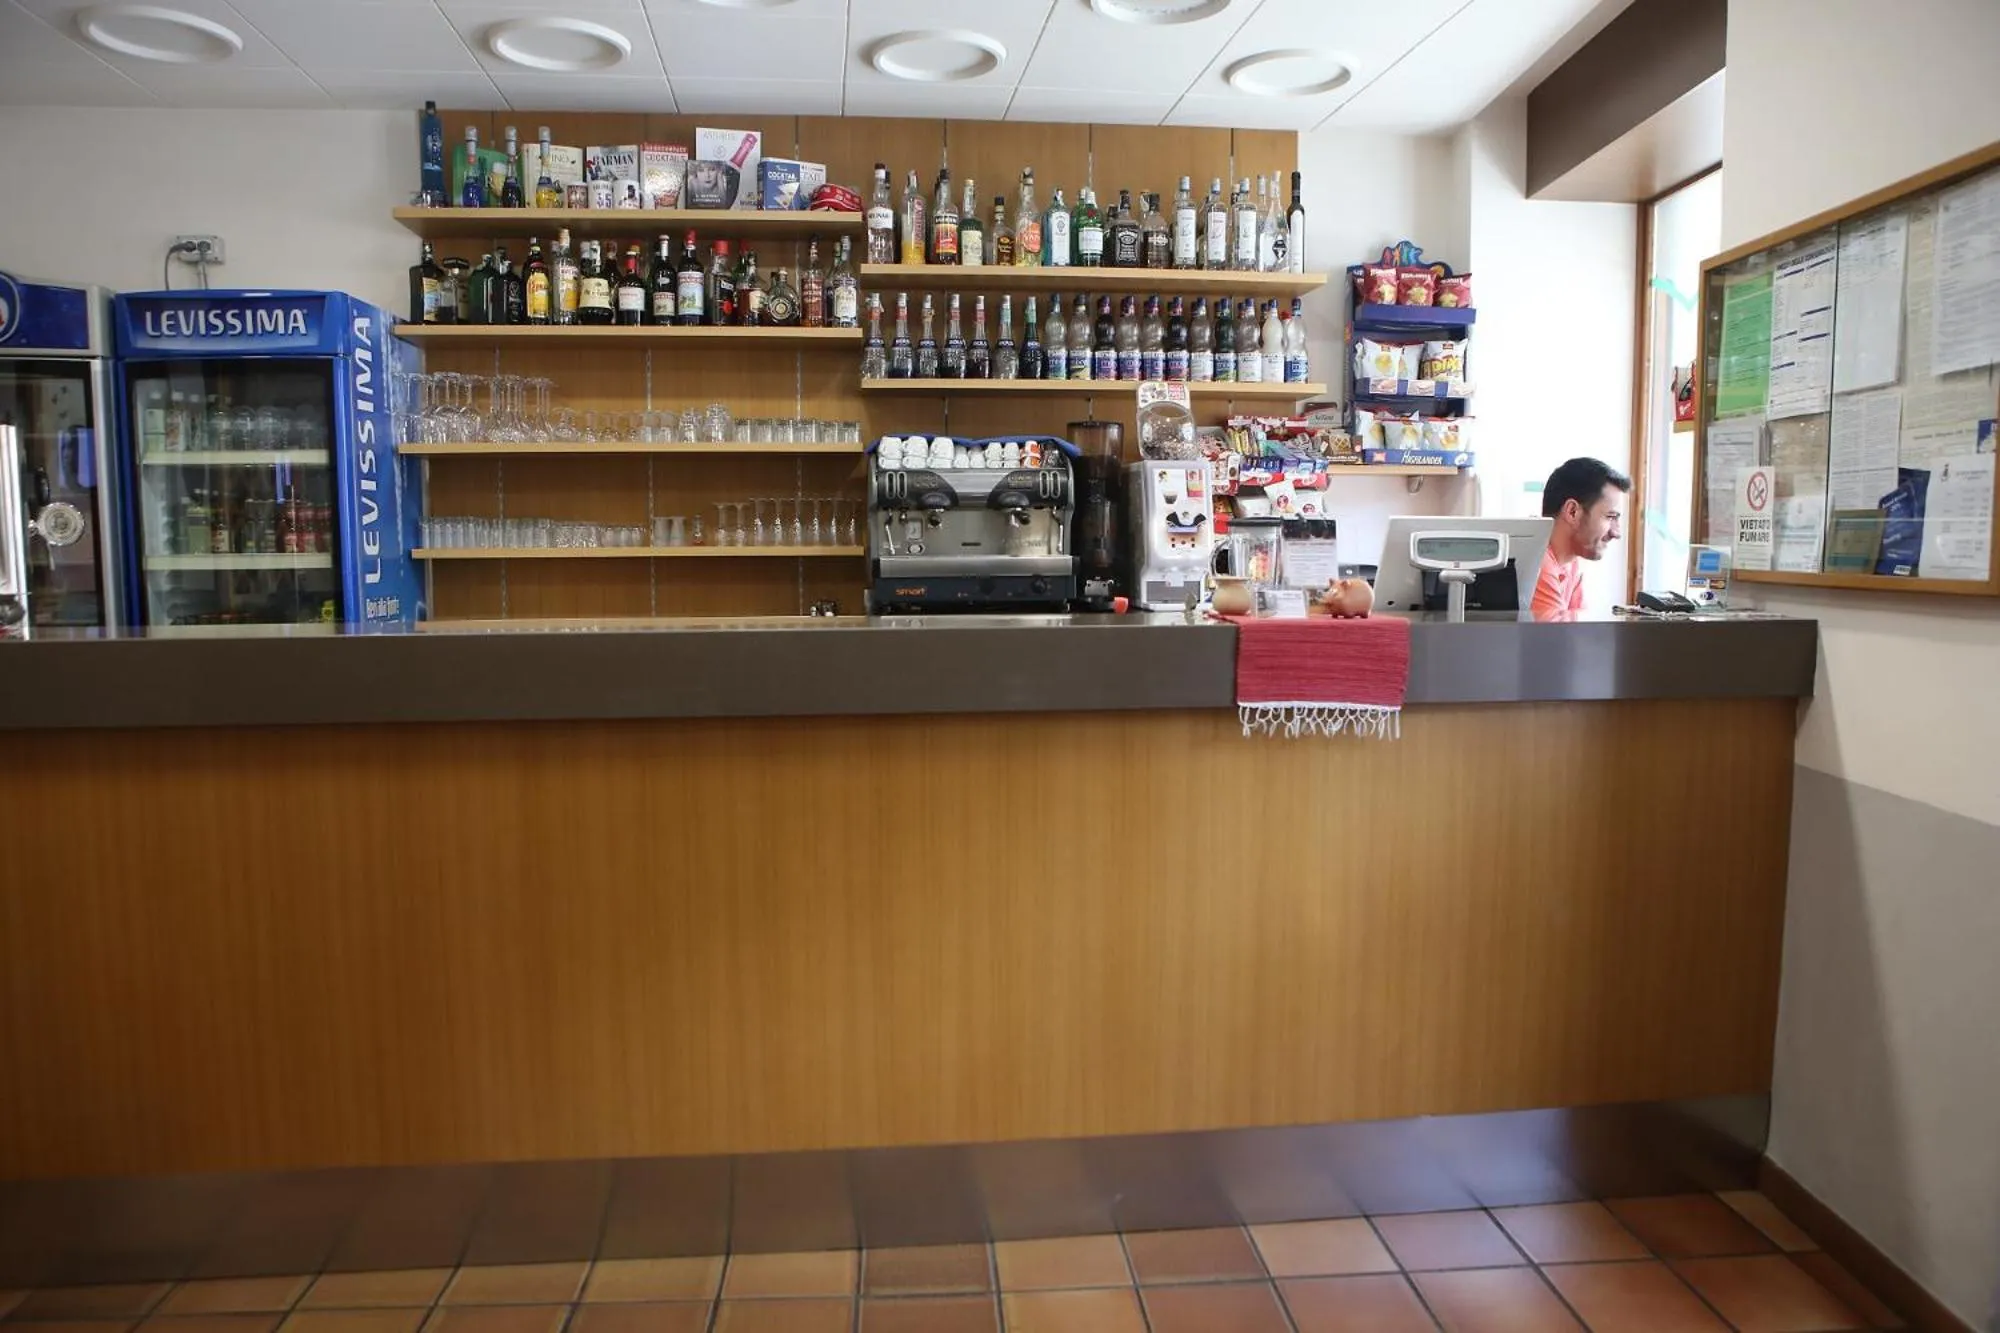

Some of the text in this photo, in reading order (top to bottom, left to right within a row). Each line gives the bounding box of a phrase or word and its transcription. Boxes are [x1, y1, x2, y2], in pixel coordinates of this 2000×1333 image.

[145, 309, 307, 336] LEVISSIMA
[354, 316, 382, 585] LEVISSIMA
[1739, 519, 1770, 531] VIETATO
[1739, 531, 1770, 543] FUMARE
